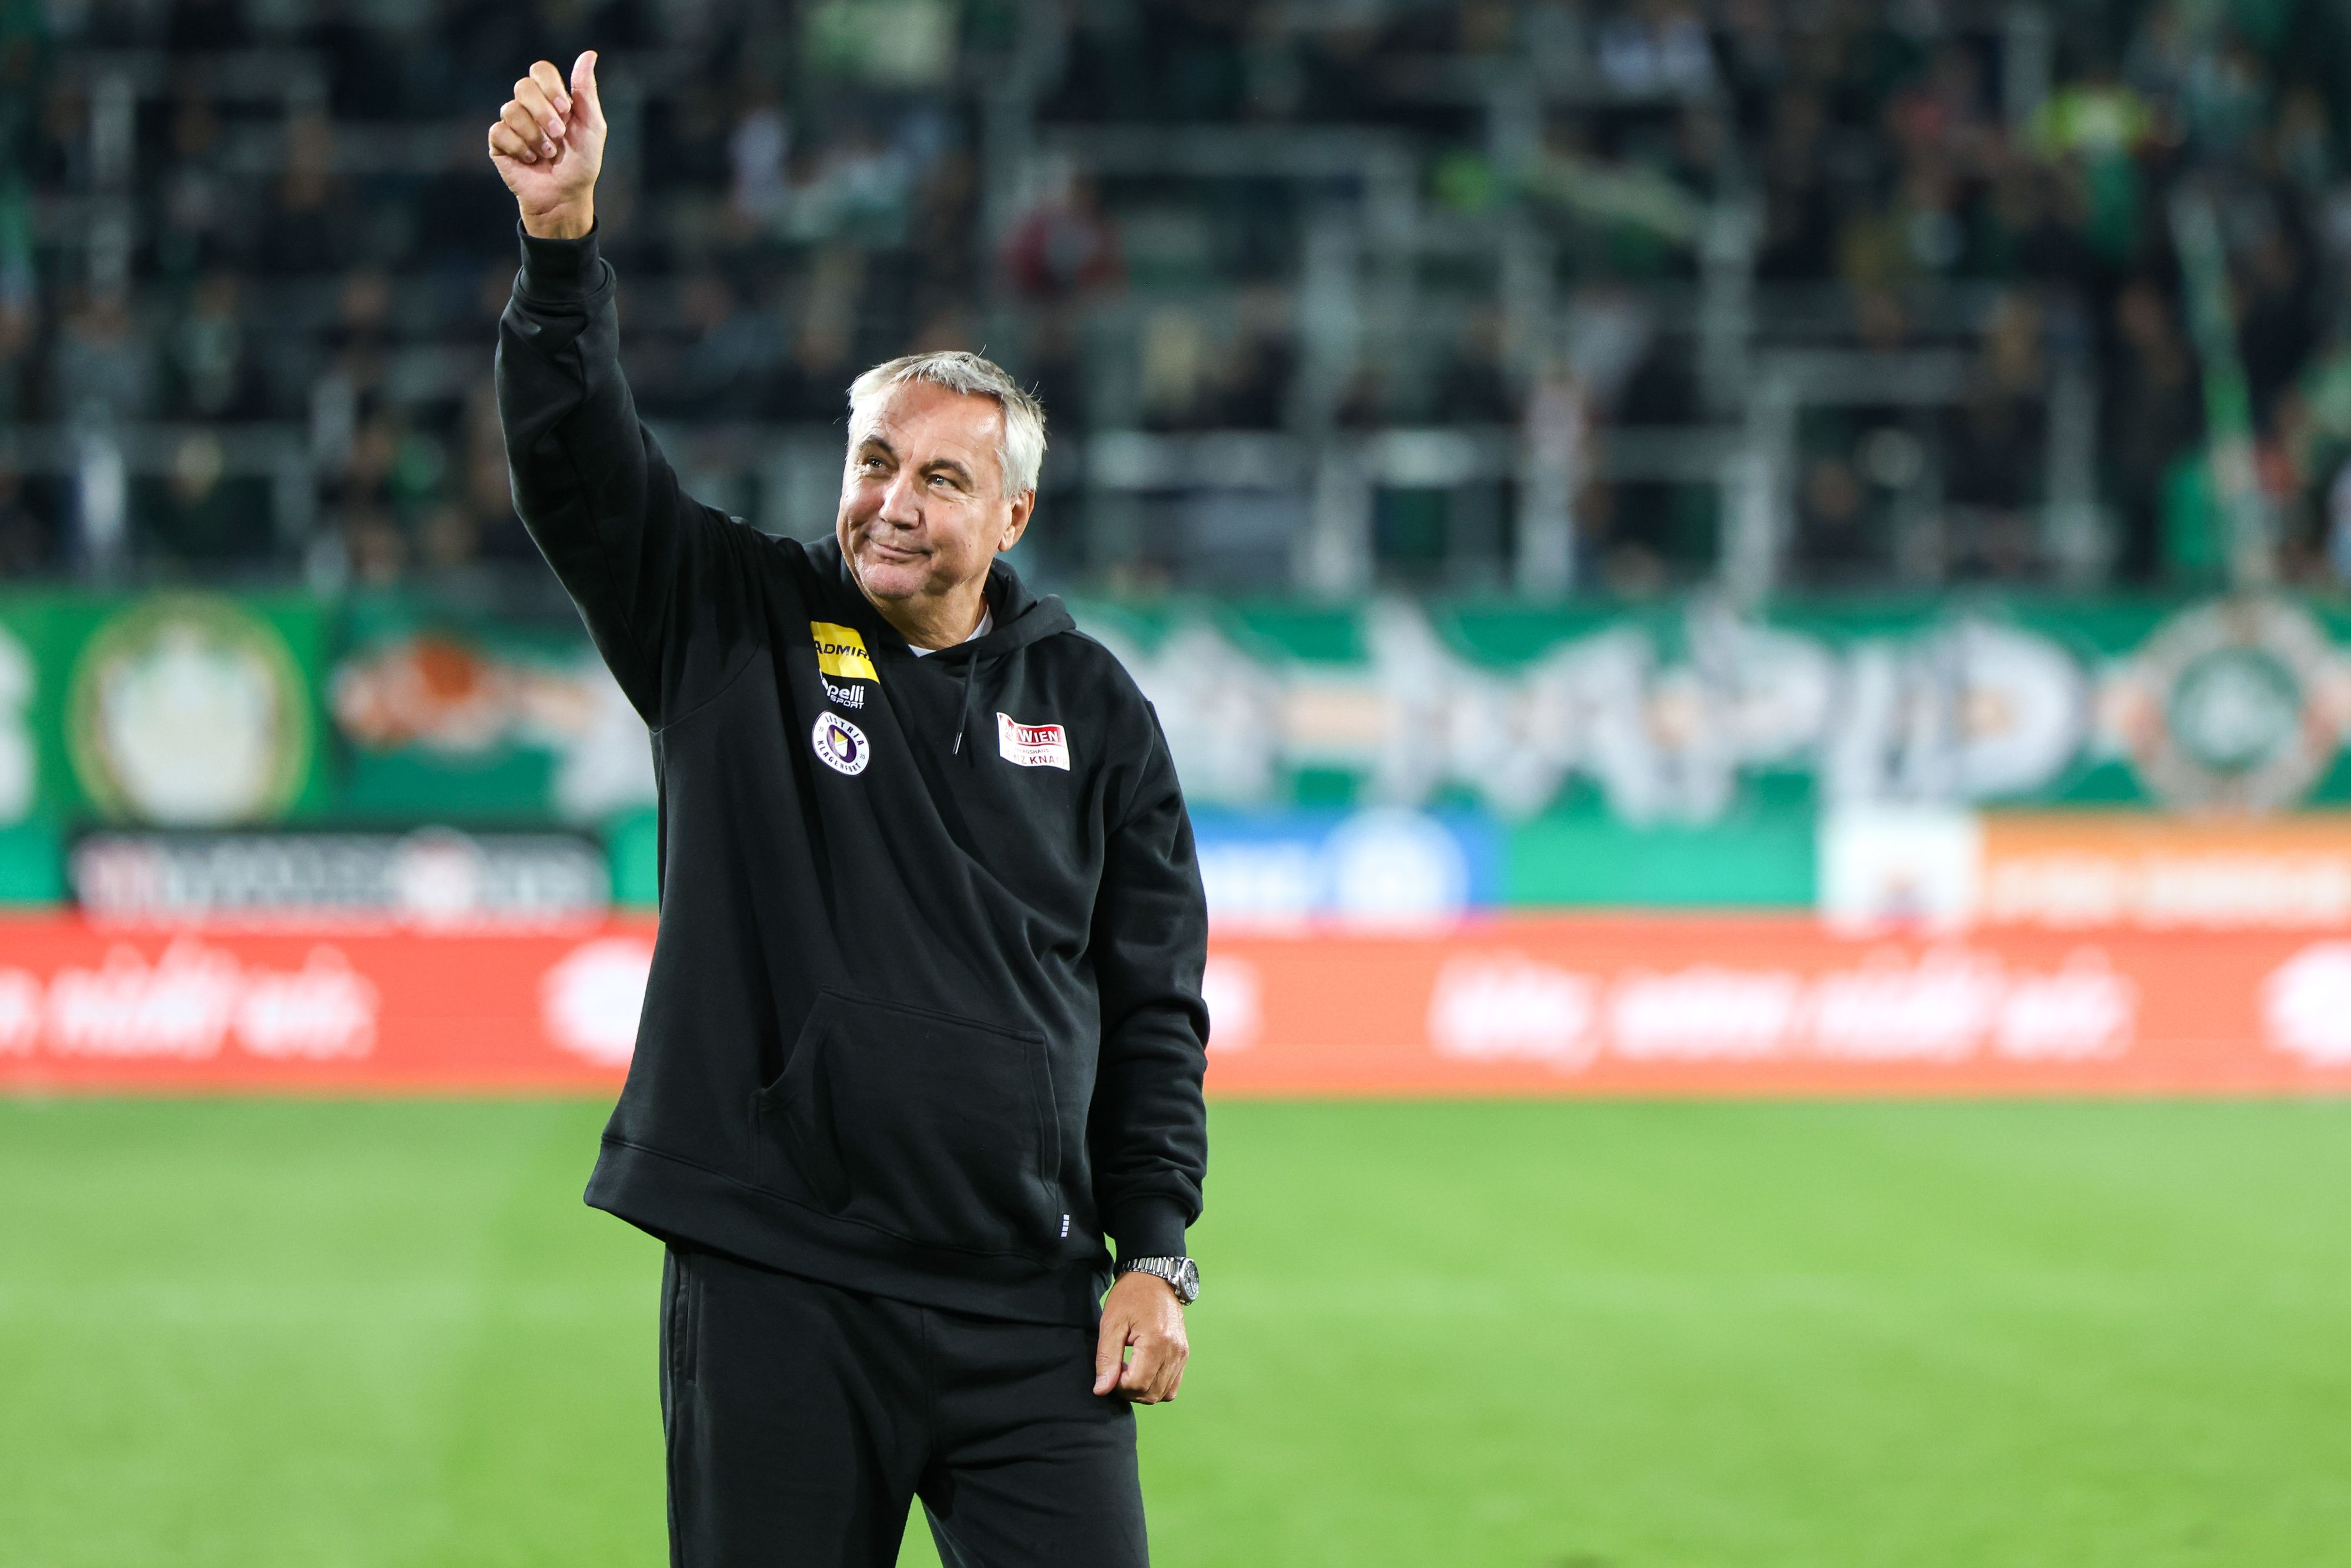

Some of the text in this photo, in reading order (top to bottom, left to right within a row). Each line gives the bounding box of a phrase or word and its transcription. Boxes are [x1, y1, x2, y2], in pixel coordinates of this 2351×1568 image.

[814, 639, 871, 661] ADMIR
[829, 695, 865, 709] SPORT
[1017, 729, 1059, 743] WIEN
